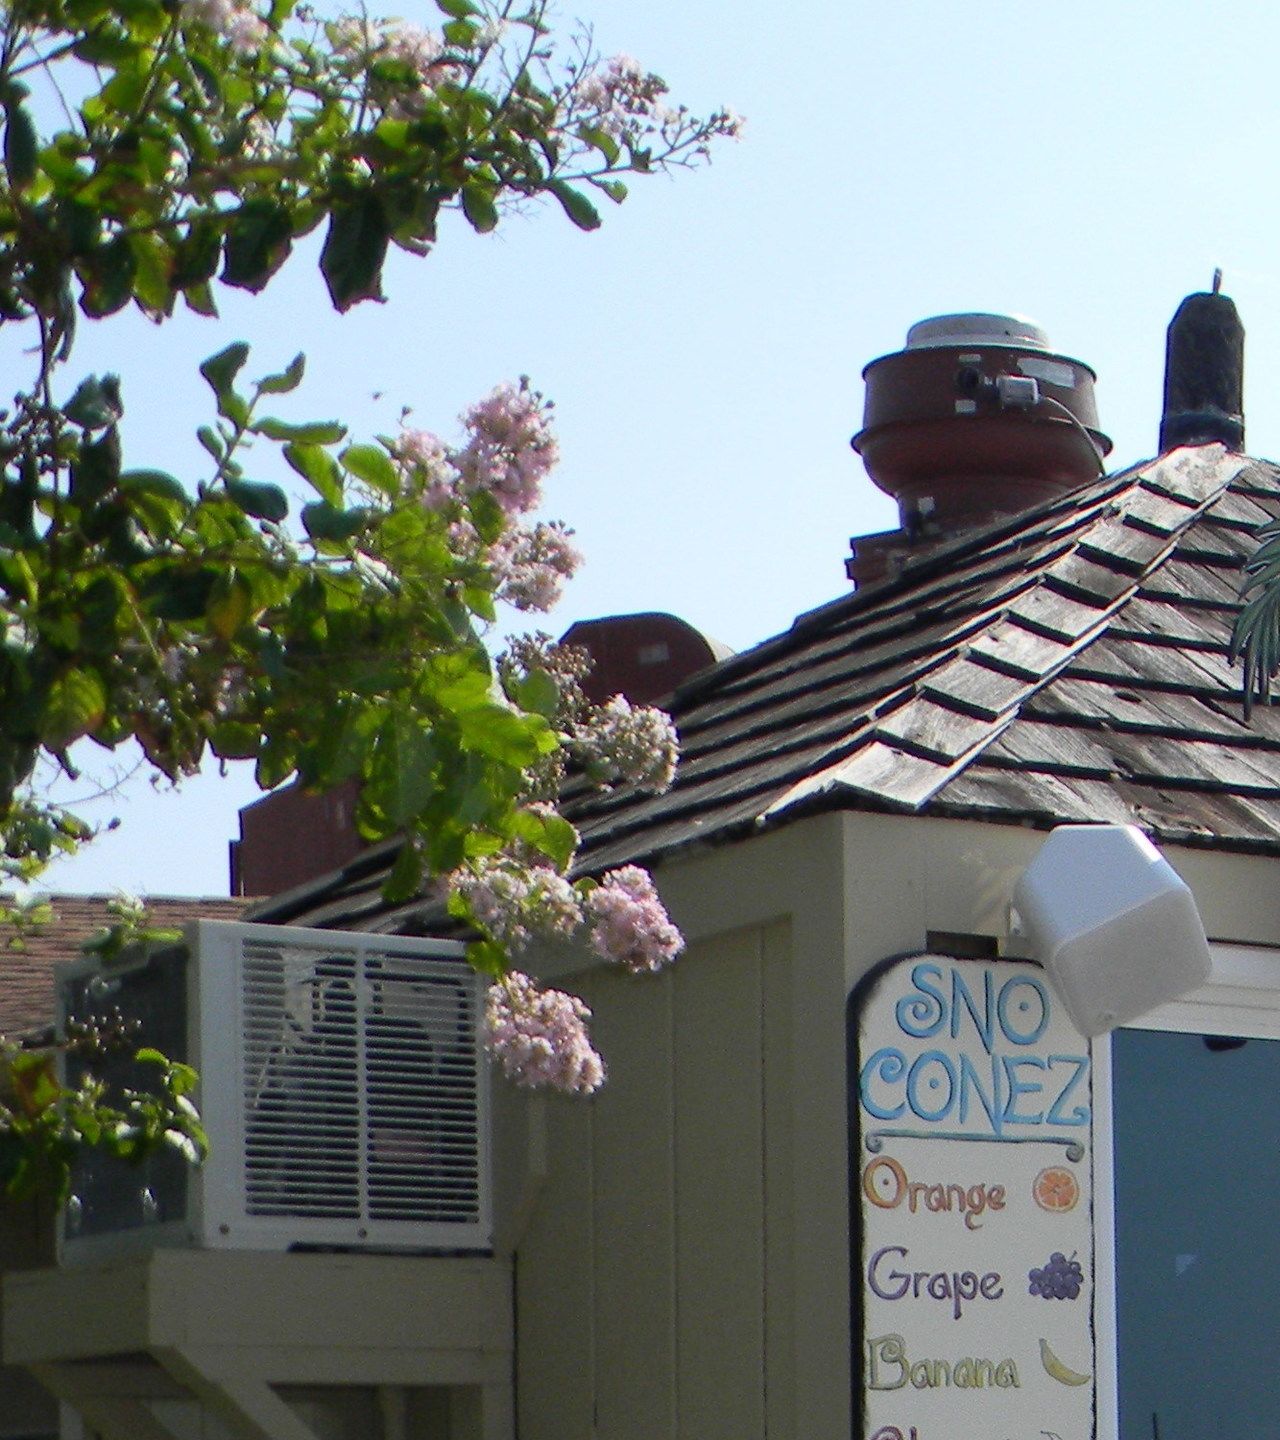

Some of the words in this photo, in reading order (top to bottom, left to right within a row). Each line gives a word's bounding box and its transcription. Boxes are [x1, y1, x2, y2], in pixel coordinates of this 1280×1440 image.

[896, 963, 1051, 1055] SNO
[859, 1045, 1090, 1135] CONEZ
[863, 1155, 1006, 1231] Orange
[868, 1245, 1004, 1320] Grape
[866, 1333, 1021, 1390] Banana
